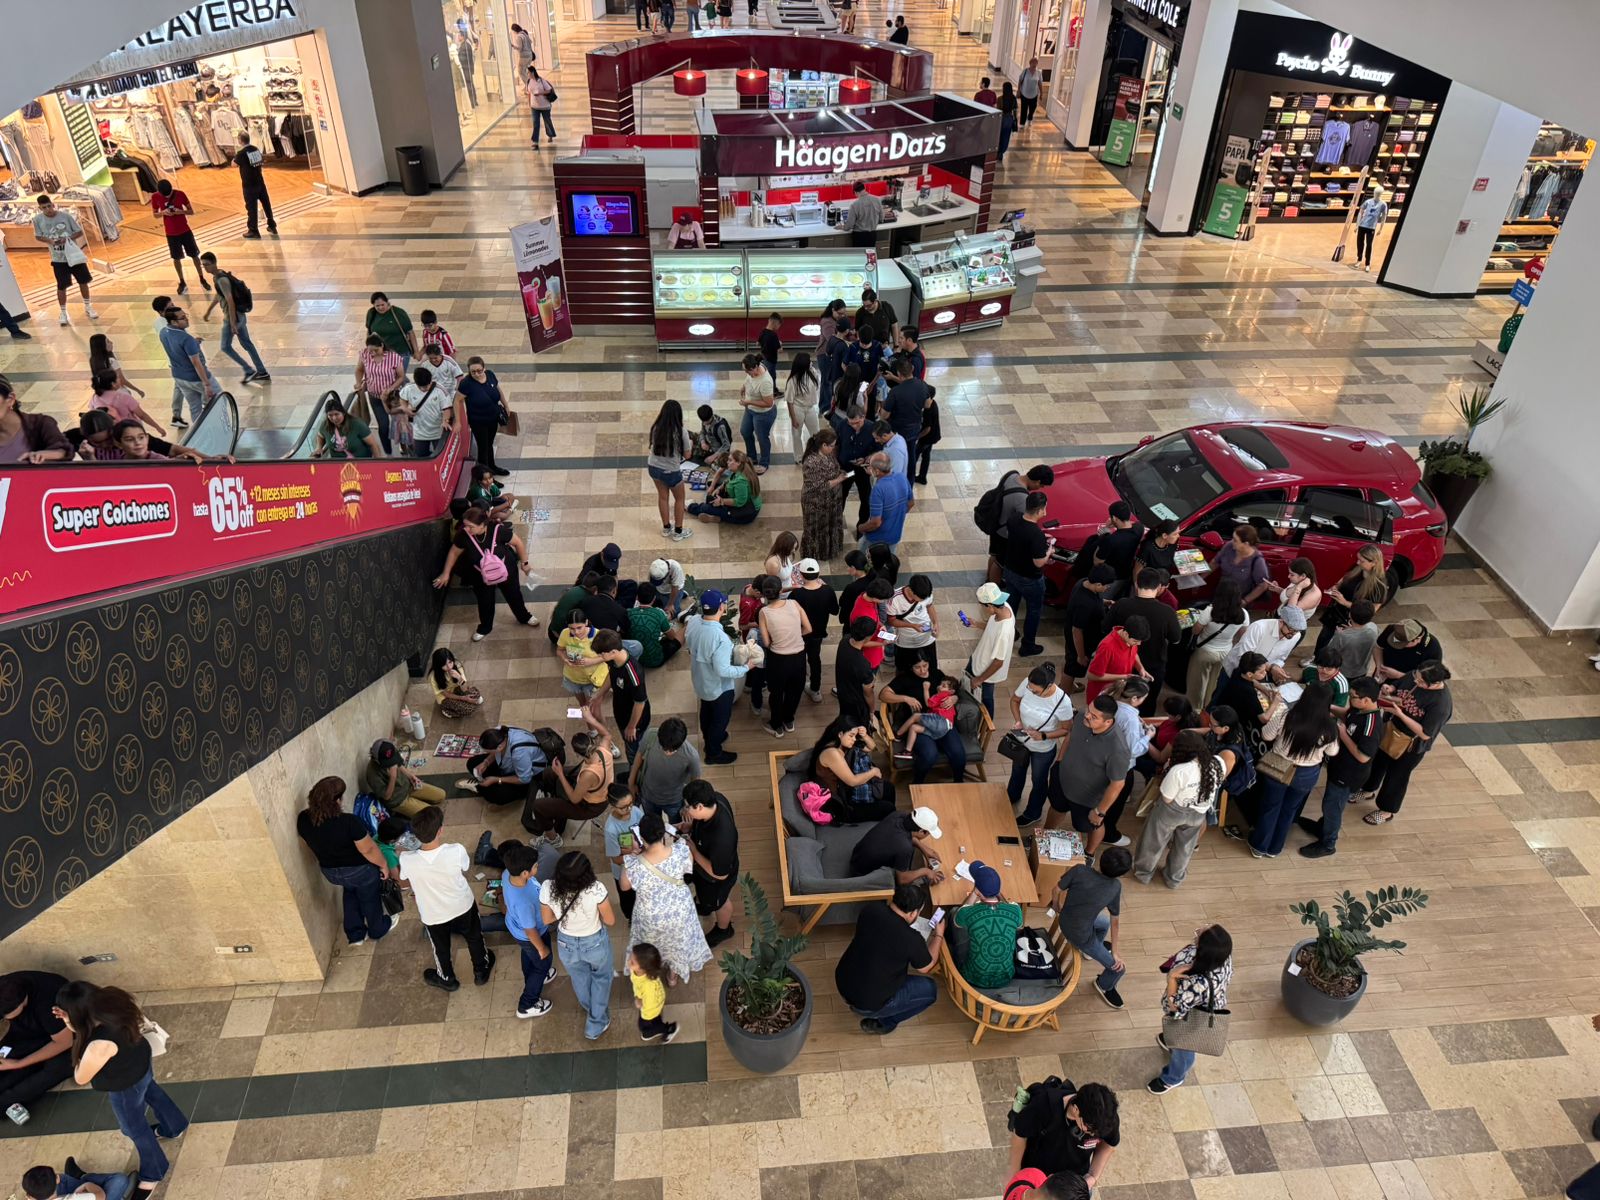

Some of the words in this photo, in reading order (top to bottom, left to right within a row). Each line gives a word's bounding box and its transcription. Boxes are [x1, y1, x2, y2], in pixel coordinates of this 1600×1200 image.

[1158, 0, 1180, 28] COLE
[101, 74, 140, 96] CUIDADO
[140, 71, 160, 87] CON
[160, 68, 171, 82] EL
[171, 62, 199, 79] PERRO
[1275, 52, 1320, 72] Psycho
[1349, 64, 1395, 87] Bunny
[775, 132, 947, 173] Häagen-Dazs
[1112, 136, 1124, 151] 5
[1218, 202, 1233, 220] 5
[193, 502, 209, 516] hasta
[208, 476, 248, 533] 65%
[240, 504, 254, 528] off
[250, 485, 262, 502] +12
[262, 486, 280, 500] meses
[280, 484, 288, 499] sin
[288, 484, 311, 499] intereses
[52, 504, 100, 534] Super
[102, 501, 170, 526] Colchones
[256, 509, 267, 523] con
[267, 506, 289, 521] entrega
[289, 507, 296, 517] en
[296, 502, 305, 519] 24
[304, 501, 318, 516] horas
